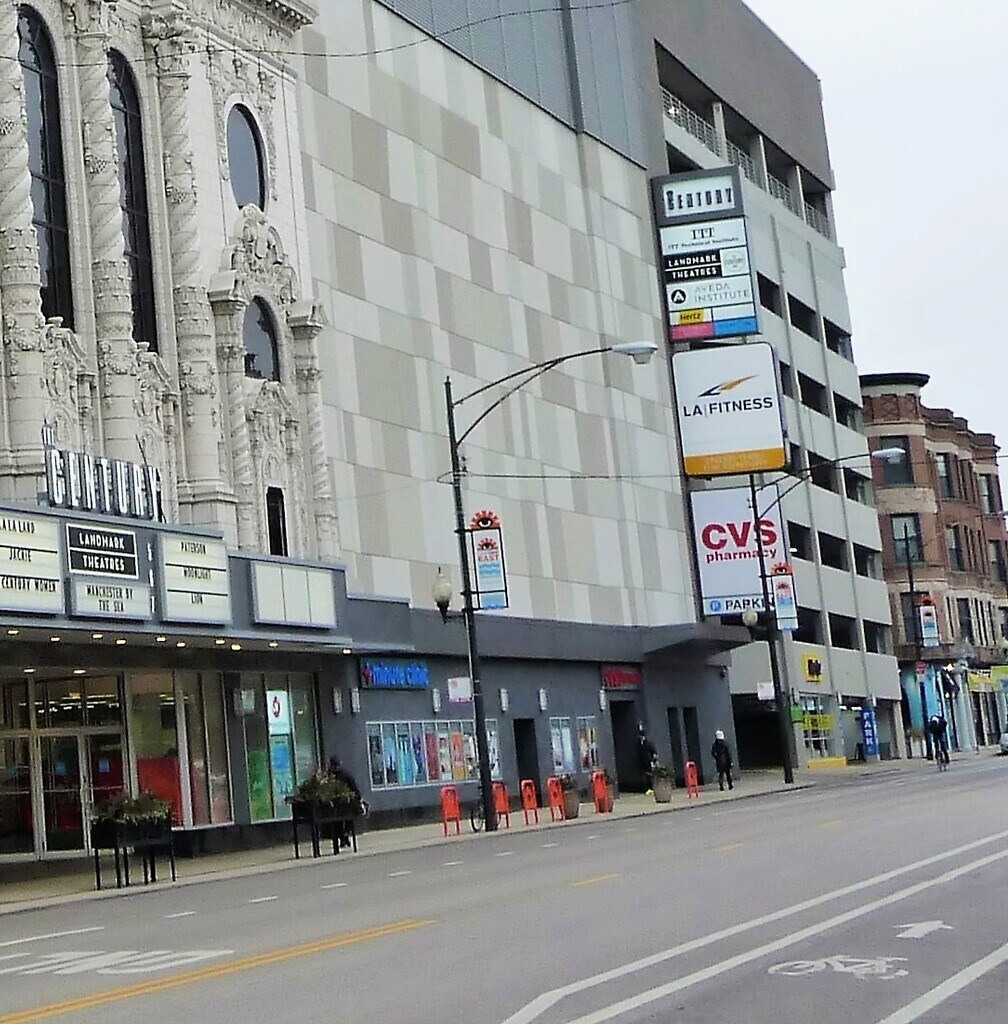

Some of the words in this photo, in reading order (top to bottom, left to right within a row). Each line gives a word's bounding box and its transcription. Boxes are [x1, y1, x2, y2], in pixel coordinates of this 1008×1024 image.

[692, 227, 715, 240] ITT
[668, 254, 718, 267] LANDMARK
[672, 267, 718, 279] THEATRES
[695, 282, 730, 293] AVEDA
[694, 289, 749, 303] INSTITUTE
[680, 312, 701, 321] Hertz
[683, 405, 703, 417] LA
[709, 397, 773, 415] FITNESS
[47, 448, 167, 524] CENTURY
[78, 532, 125, 550] LANDMARK
[701, 520, 778, 550] CVS
[180, 541, 207, 555] PATERSON
[82, 554, 125, 571] THEATRES
[706, 547, 777, 564] pharmacy
